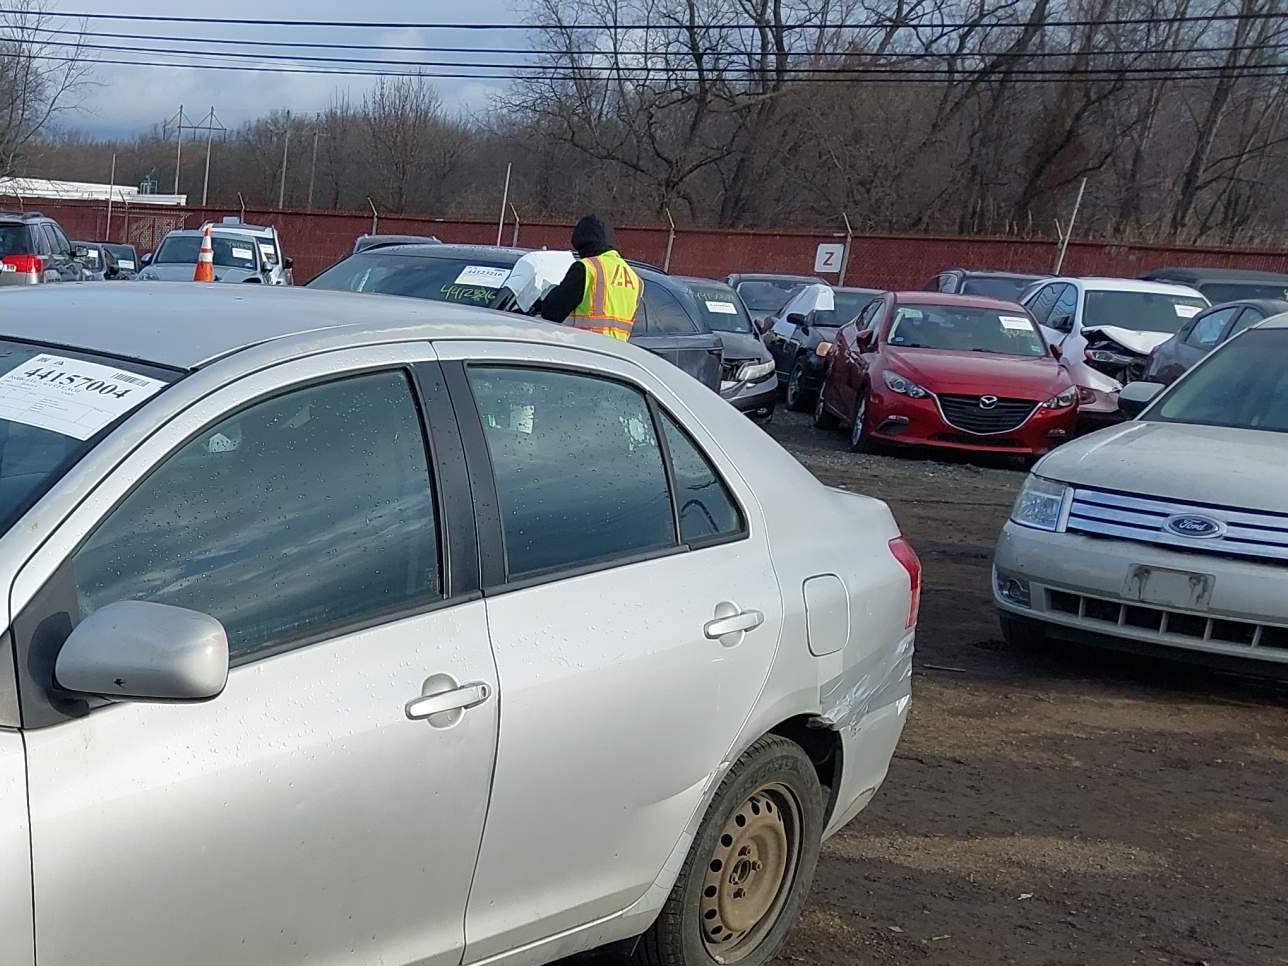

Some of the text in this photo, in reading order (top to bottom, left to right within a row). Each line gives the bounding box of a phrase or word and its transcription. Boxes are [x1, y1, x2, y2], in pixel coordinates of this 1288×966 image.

[823, 252, 835, 266] Z
[24, 367, 133, 399] 44157004
[1178, 518, 1208, 531] Ford
